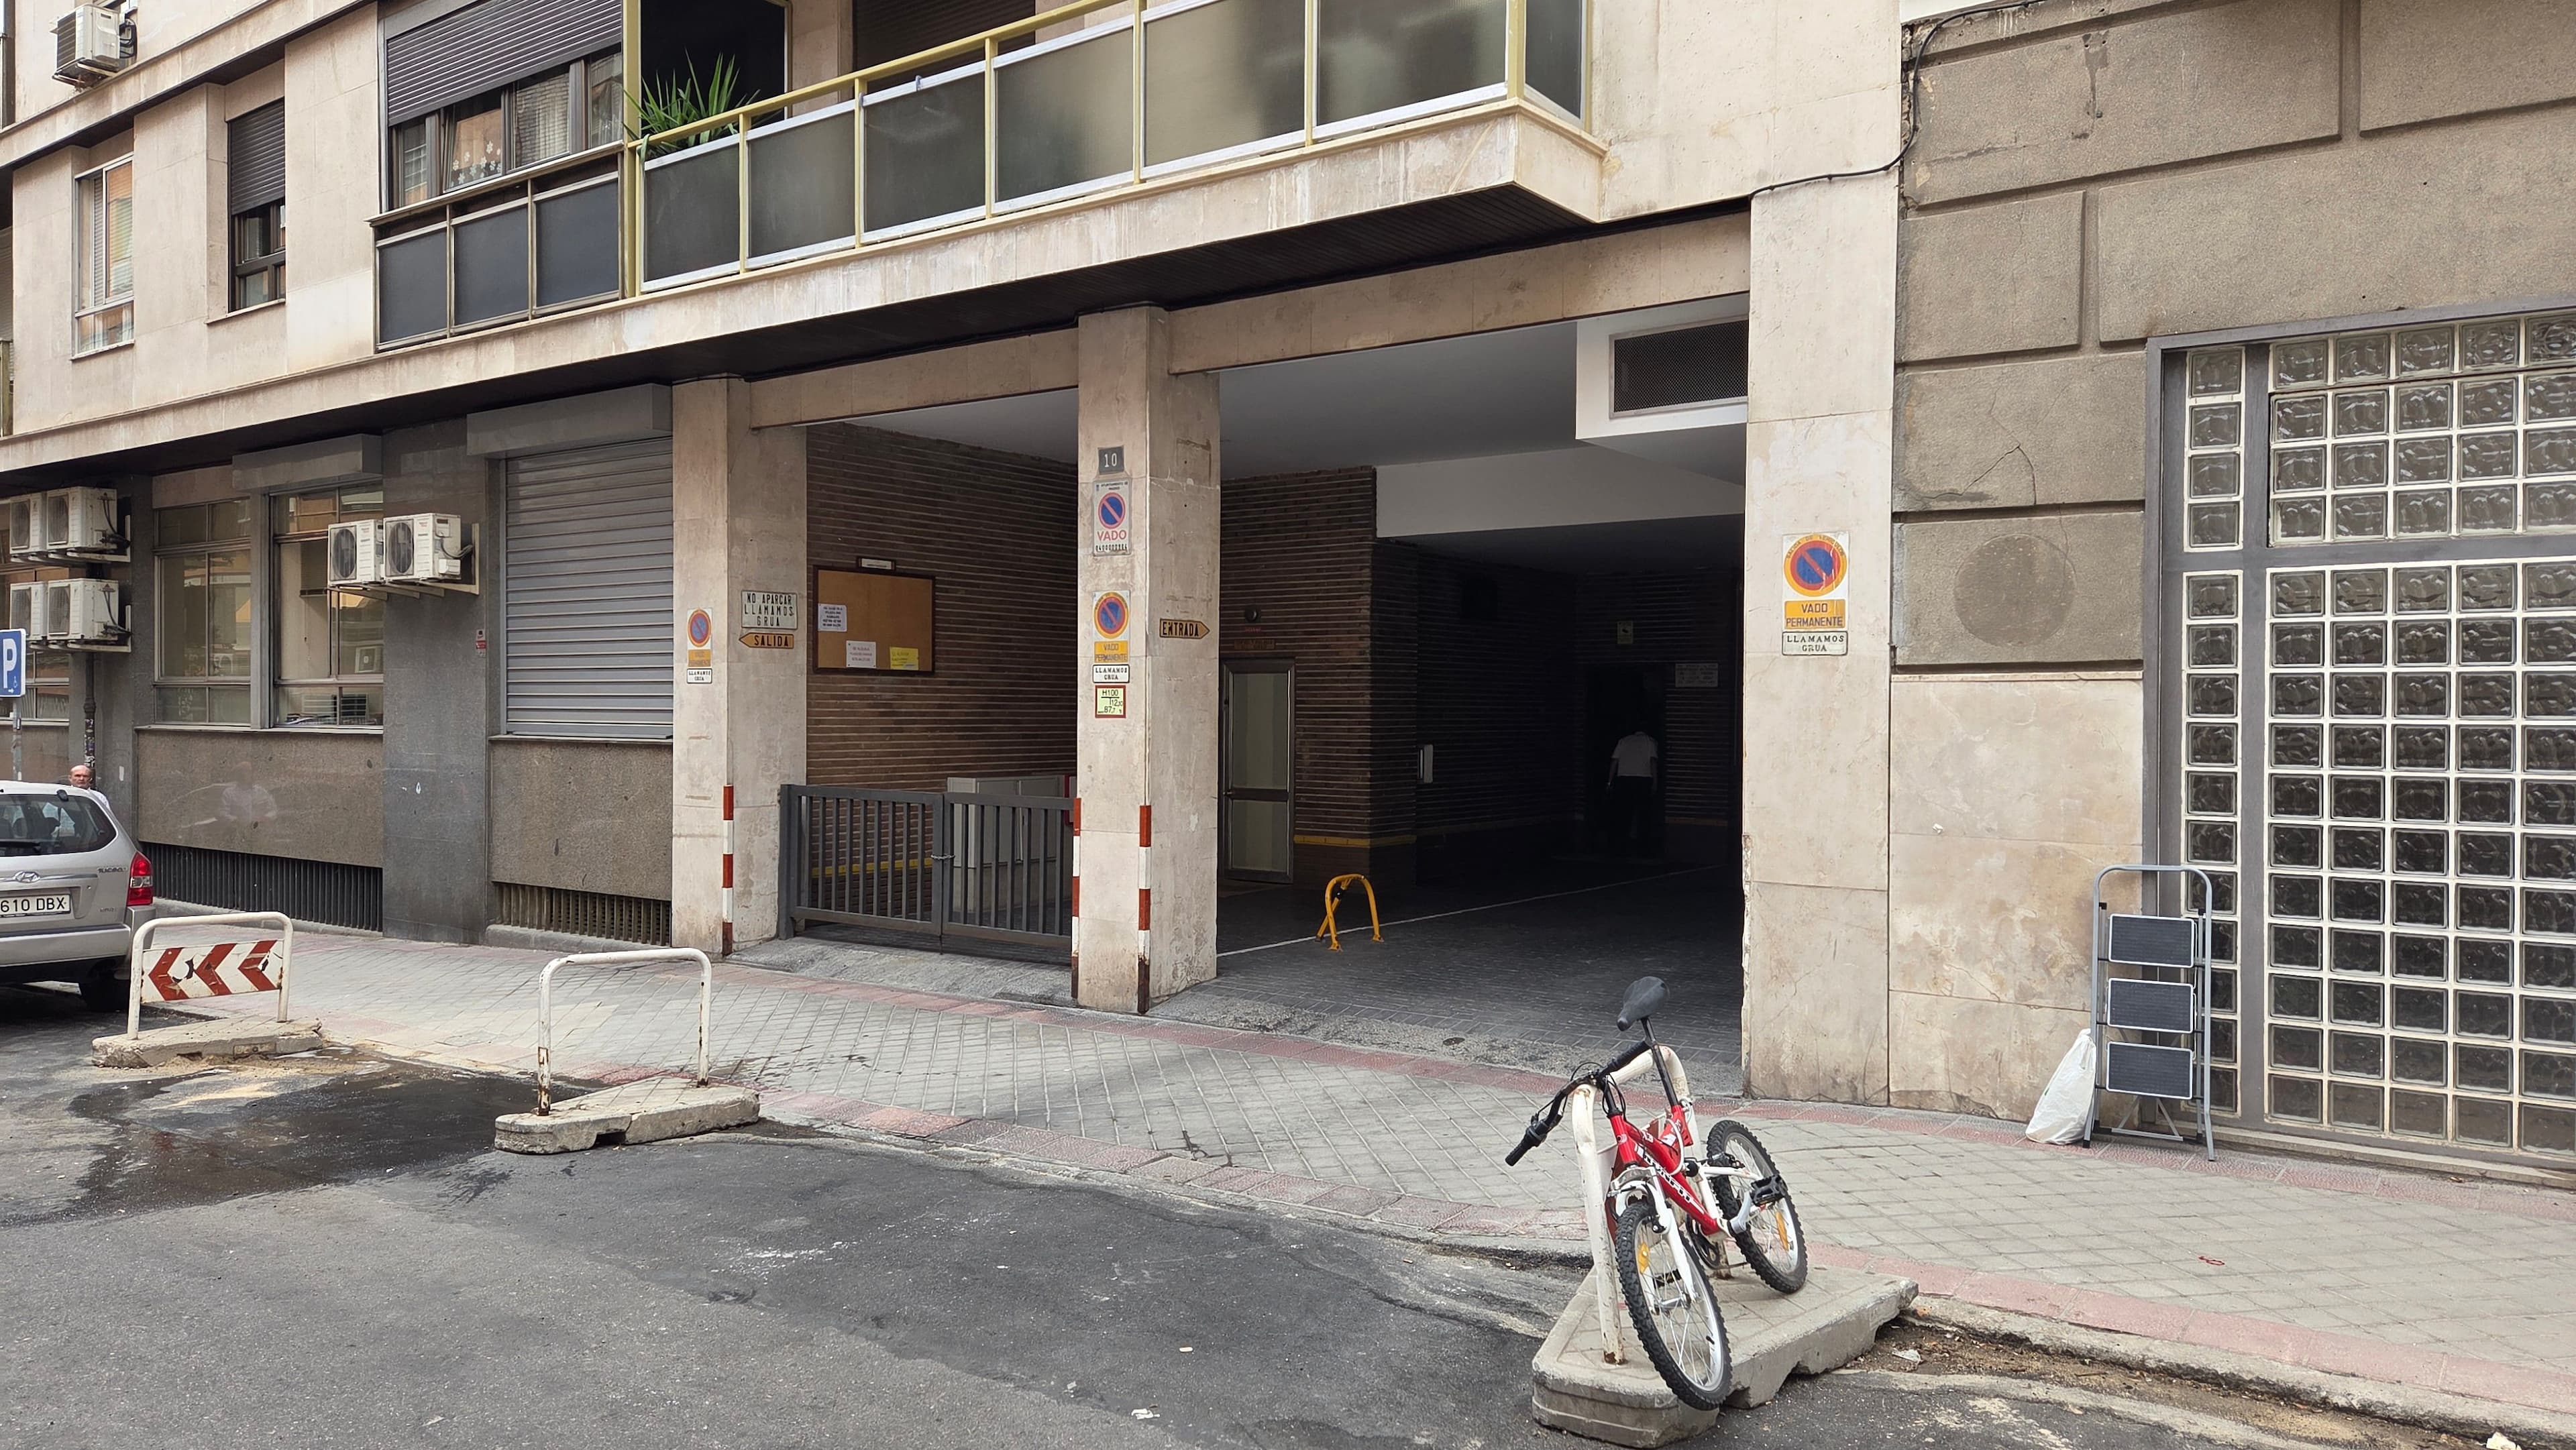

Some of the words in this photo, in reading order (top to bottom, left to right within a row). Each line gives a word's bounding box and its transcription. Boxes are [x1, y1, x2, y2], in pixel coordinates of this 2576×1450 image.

[1104, 453, 1118, 467] 10
[1097, 530, 1127, 541] VADO
[747, 593, 756, 604] NO
[762, 594, 792, 605] APARCAR
[744, 604, 793, 616] LLAMAMOS
[1801, 603, 1828, 613] VADO
[757, 616, 780, 626] GRUA
[1786, 616, 1843, 628] PERMANENTE
[1163, 621, 1199, 636] ENTRADA
[754, 634, 789, 647] SALIDA
[3, 638, 17, 689] P
[36, 897, 65, 911] DBX
